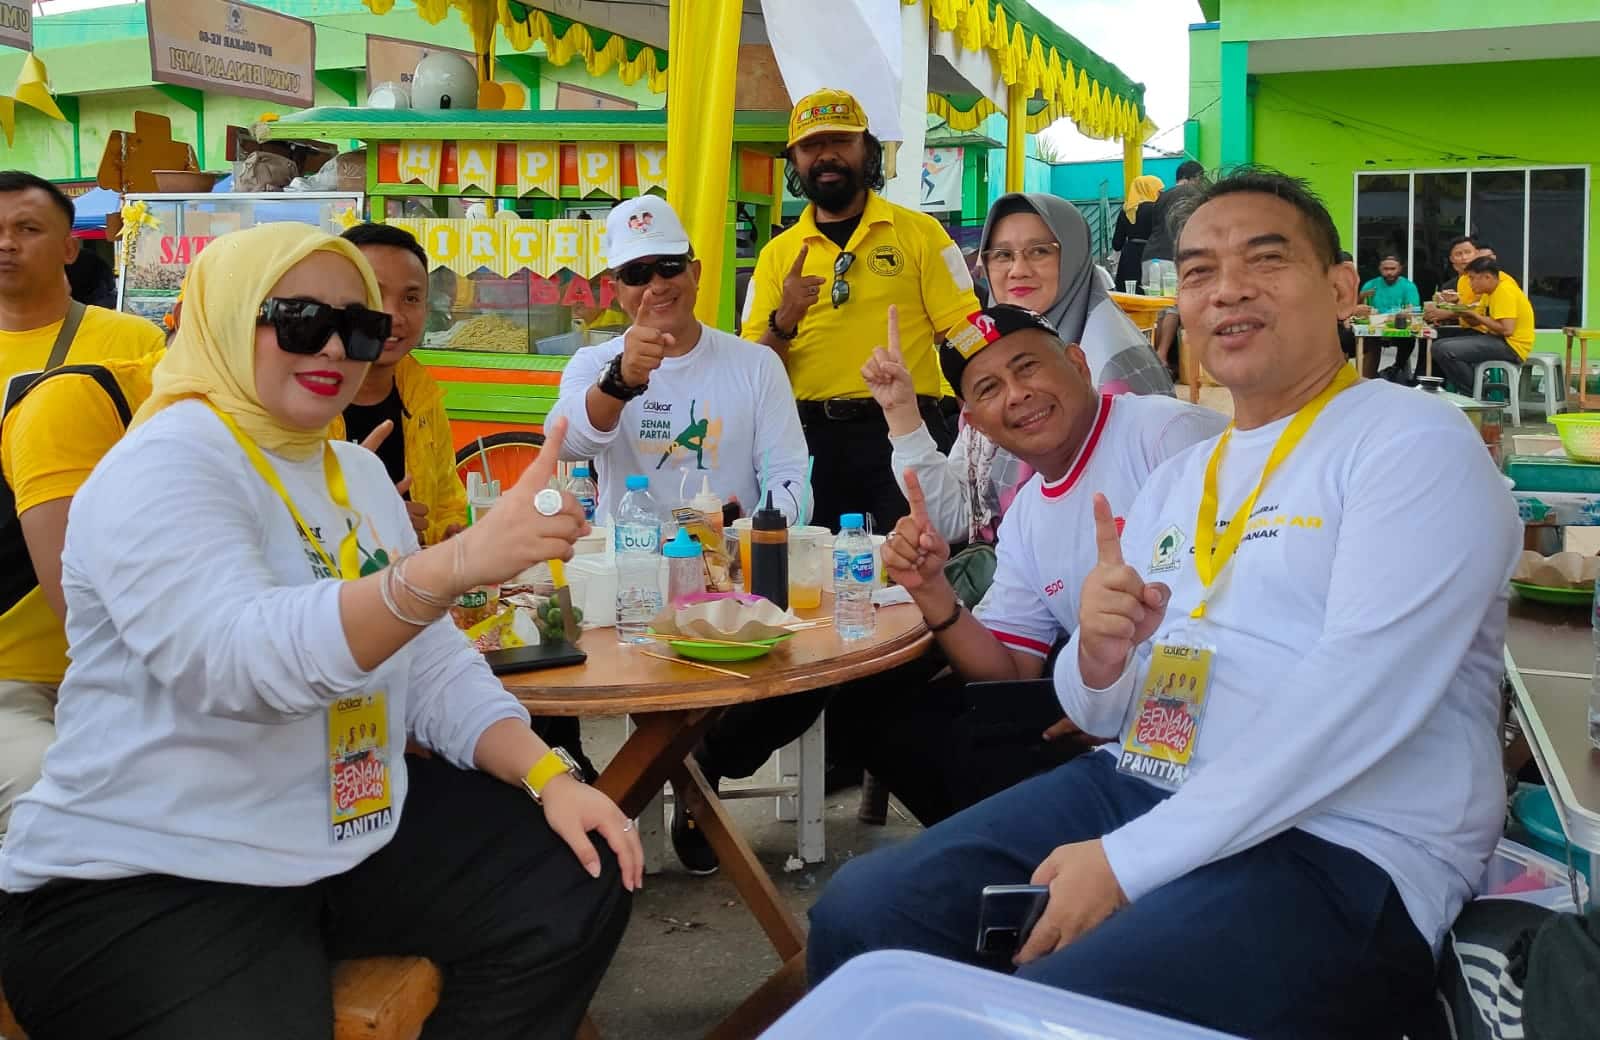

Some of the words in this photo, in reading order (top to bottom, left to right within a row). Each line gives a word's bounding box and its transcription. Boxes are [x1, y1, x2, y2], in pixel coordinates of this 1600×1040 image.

[405, 143, 666, 178] HAPPY
[437, 231, 578, 258] IRTH
[639, 430, 671, 440] PARTAI
[640, 419, 671, 430] SENAM
[625, 535, 651, 547] blu
[1140, 706, 1193, 738] SENAM
[1138, 726, 1187, 751] GOLKAR
[336, 761, 385, 794] SENAM
[1120, 751, 1186, 783] PANITIA
[338, 783, 384, 810] GOLKAR
[334, 808, 392, 842] PANITIA
